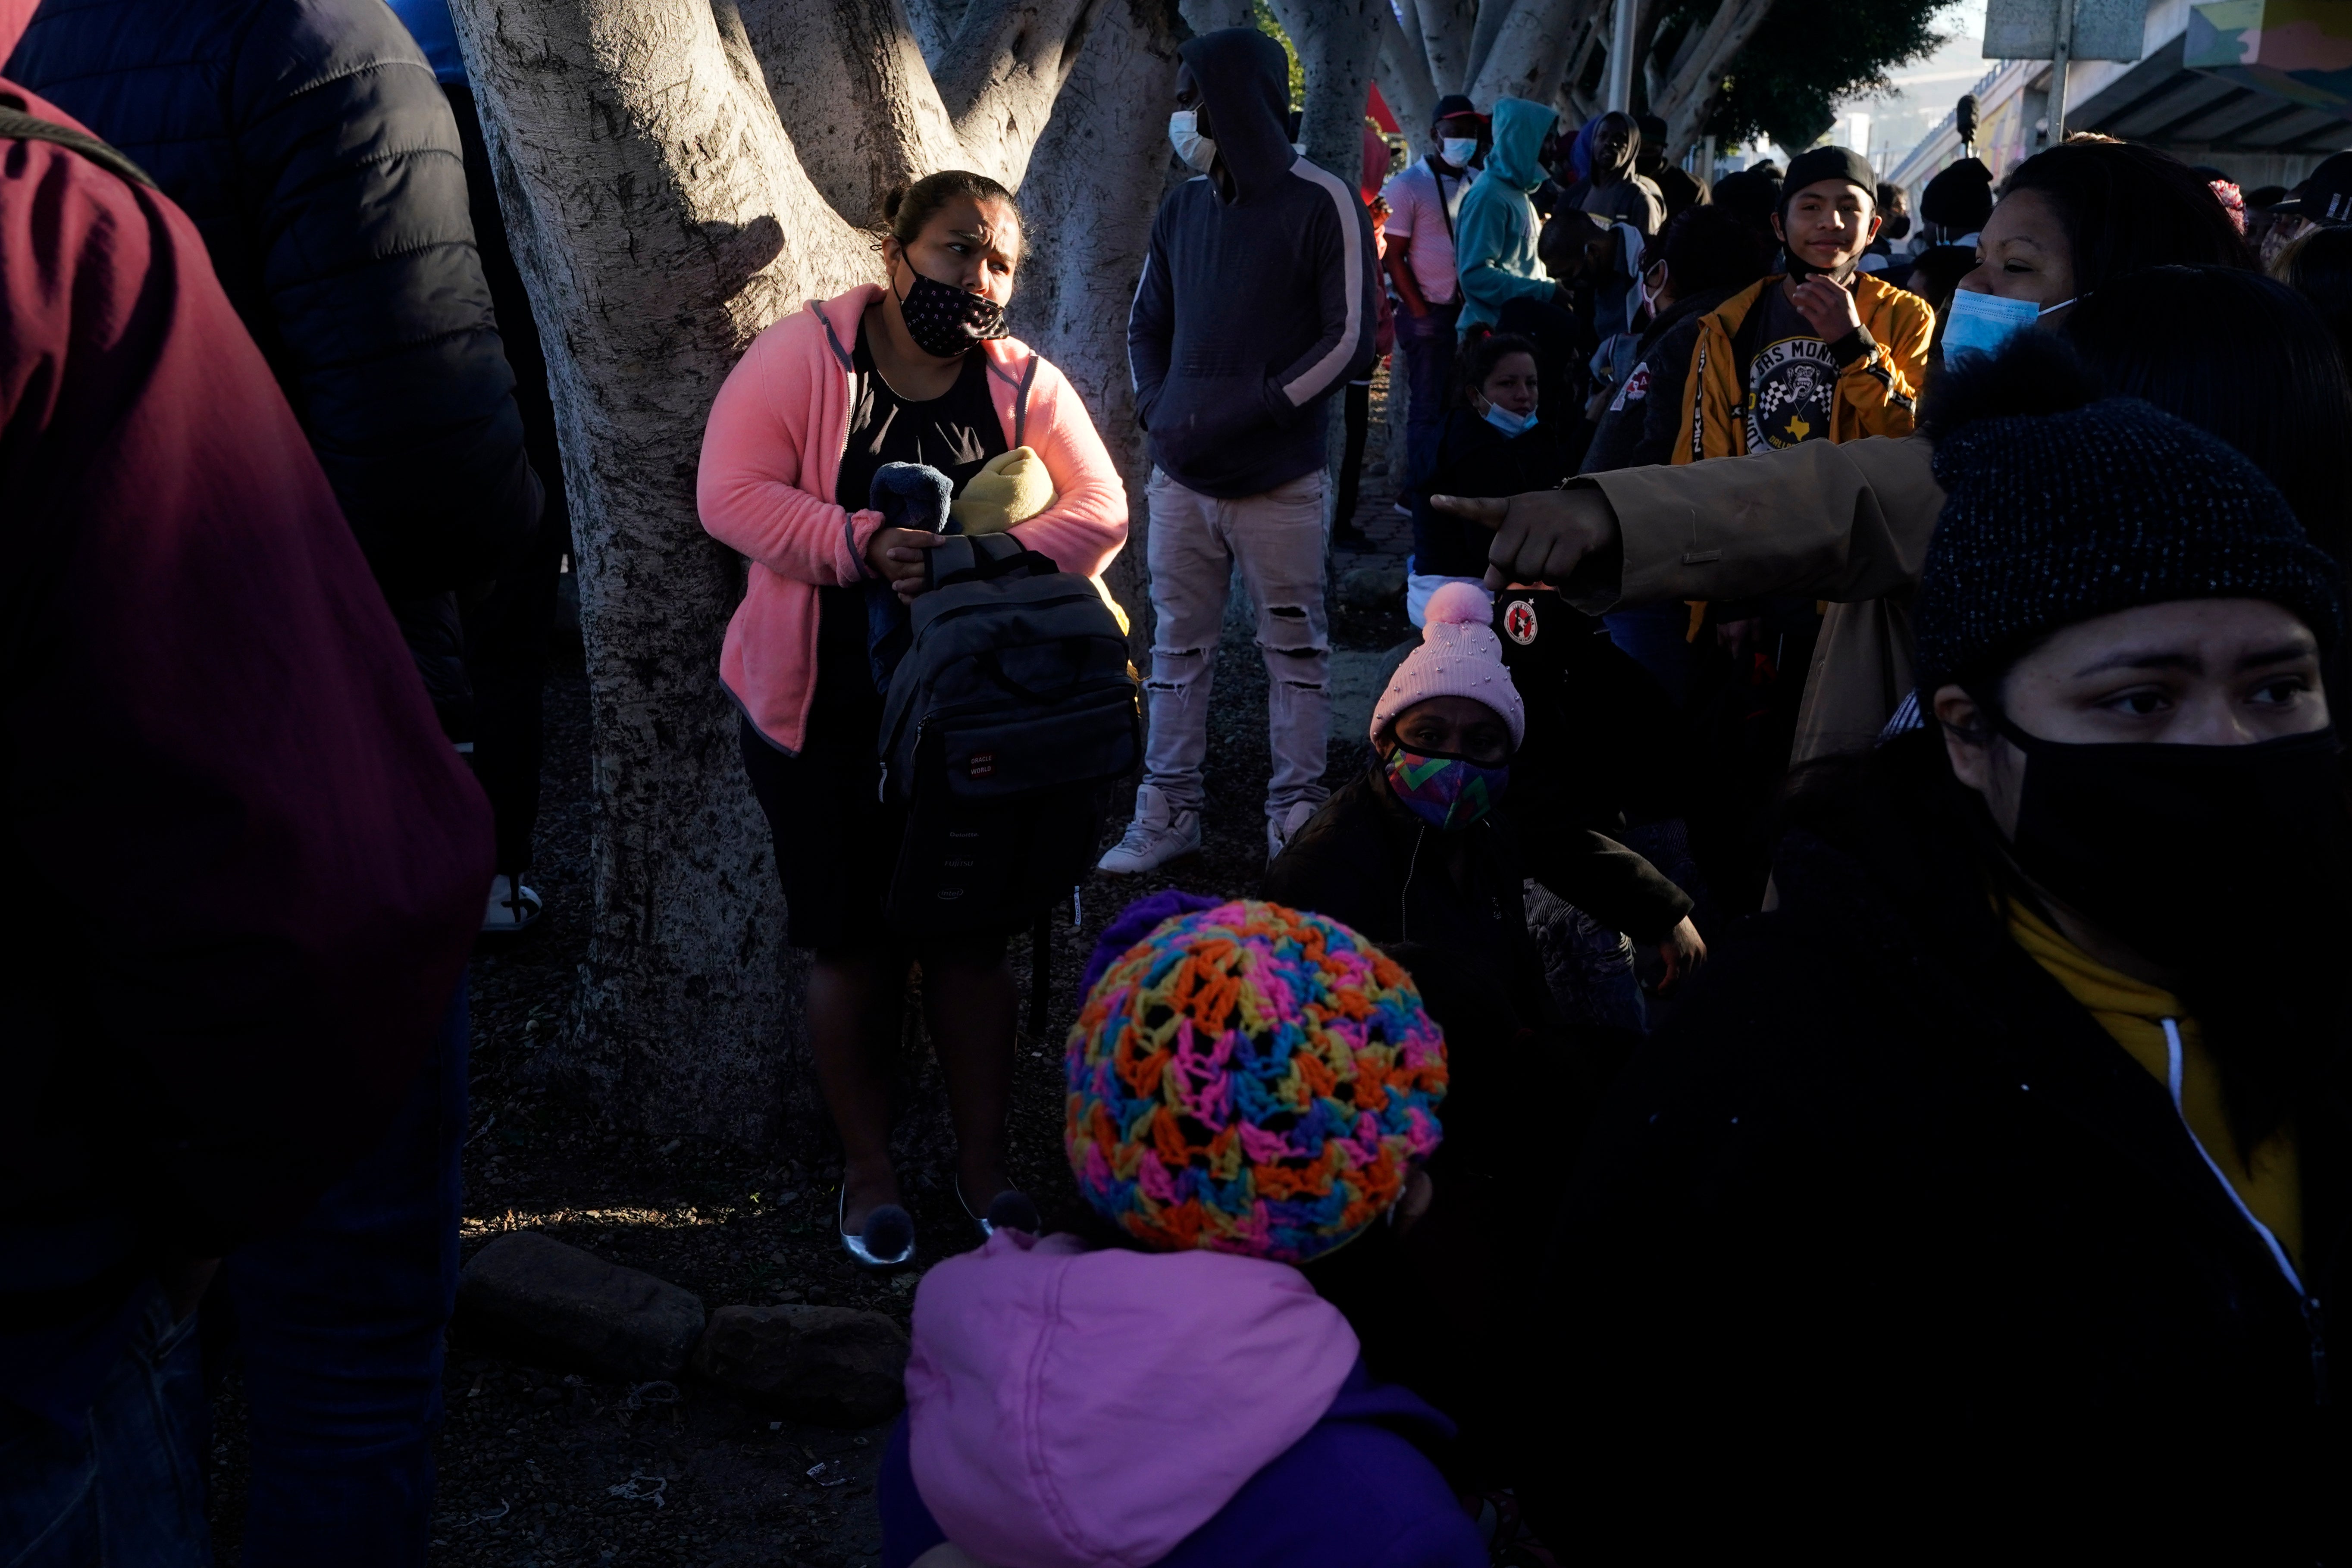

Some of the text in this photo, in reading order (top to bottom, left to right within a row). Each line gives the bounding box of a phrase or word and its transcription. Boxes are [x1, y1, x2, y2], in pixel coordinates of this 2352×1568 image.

[1755, 347, 1784, 376] GAS
[971, 755, 992, 764] ORACLE
[971, 766, 991, 775] WORLD
